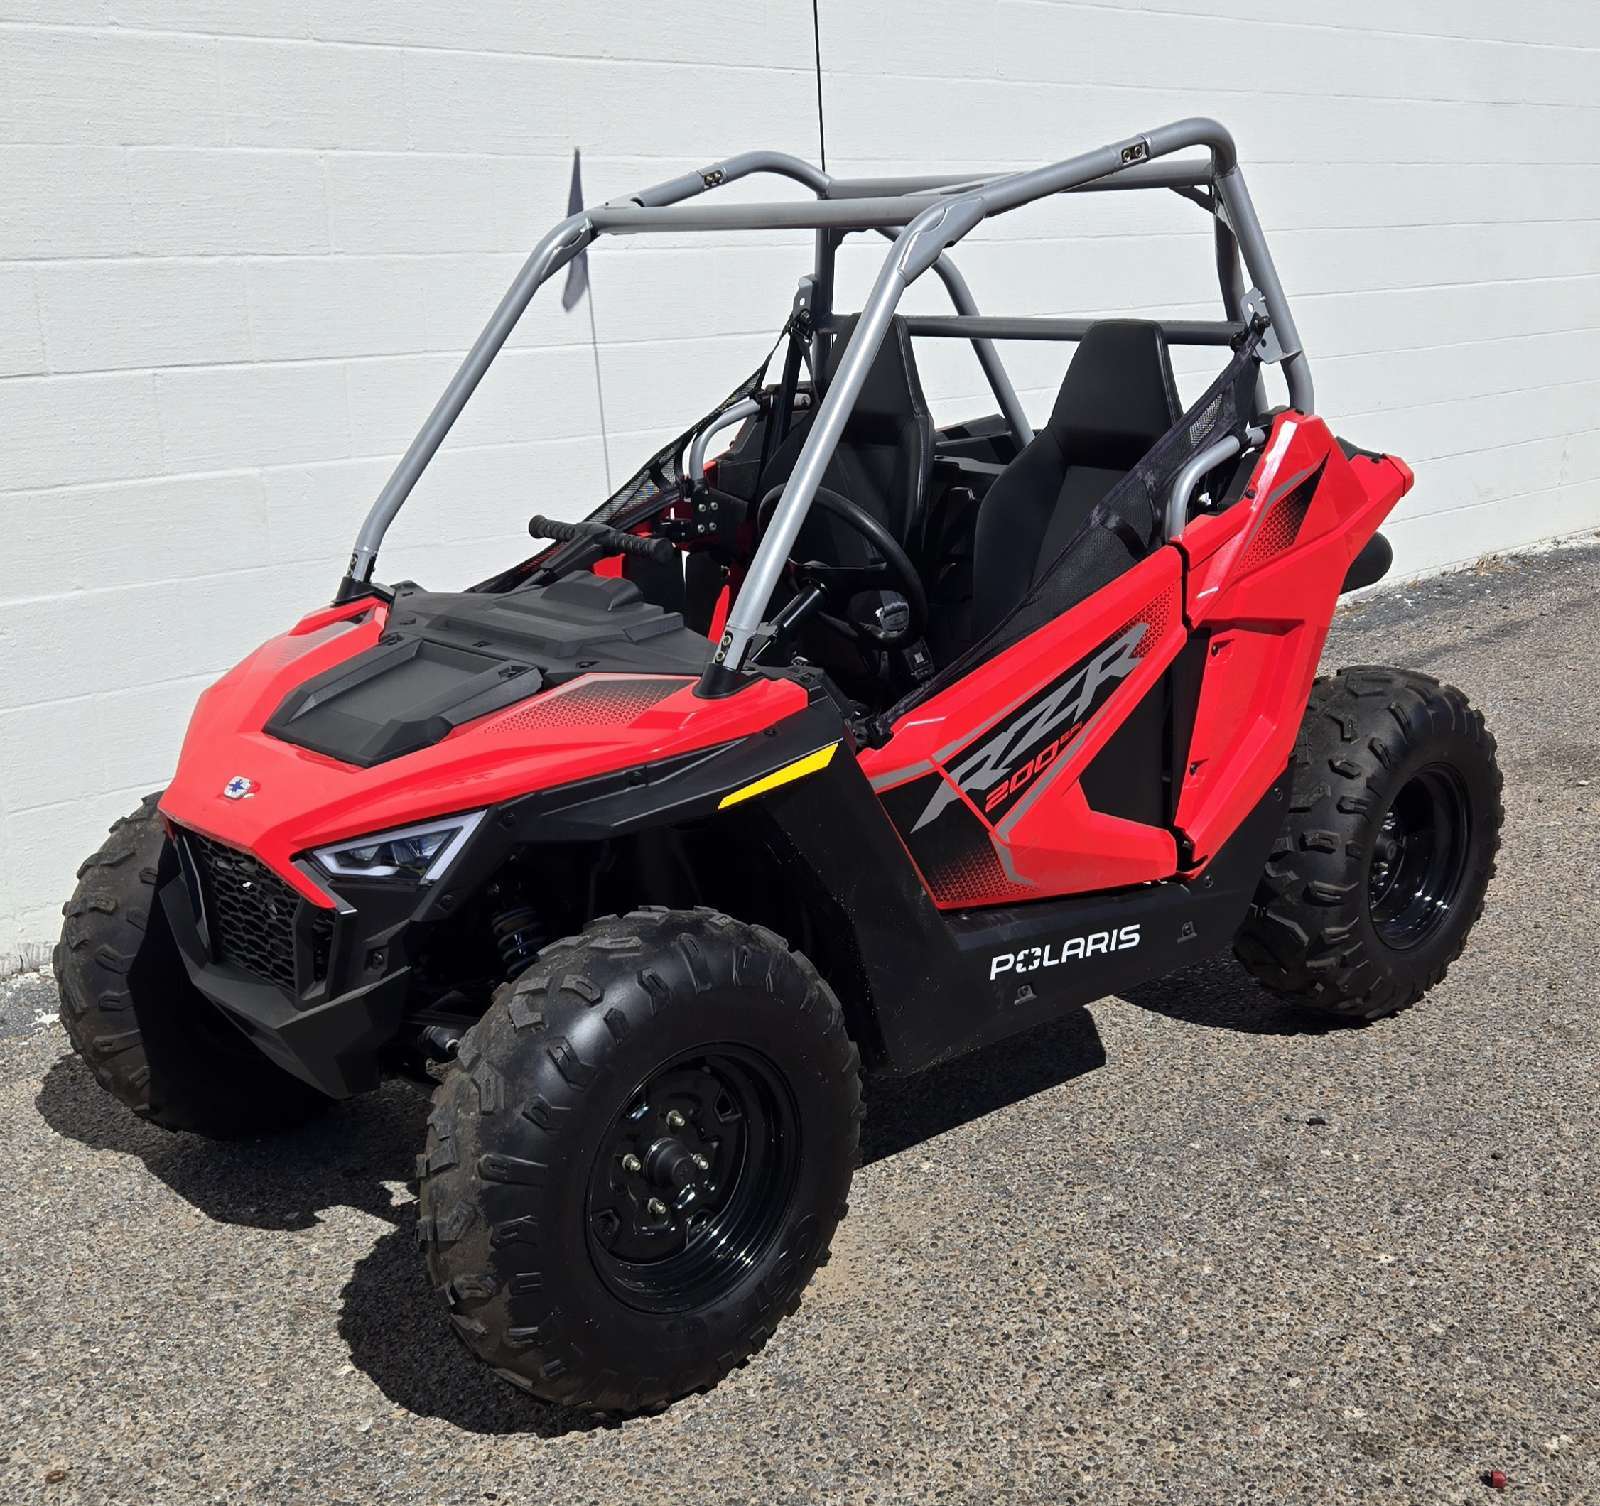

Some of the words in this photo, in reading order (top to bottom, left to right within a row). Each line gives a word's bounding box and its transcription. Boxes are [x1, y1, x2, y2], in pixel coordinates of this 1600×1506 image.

[910, 622, 1151, 834] RZR
[985, 738, 1060, 813] 200
[989, 923, 1141, 981] POLARIS
